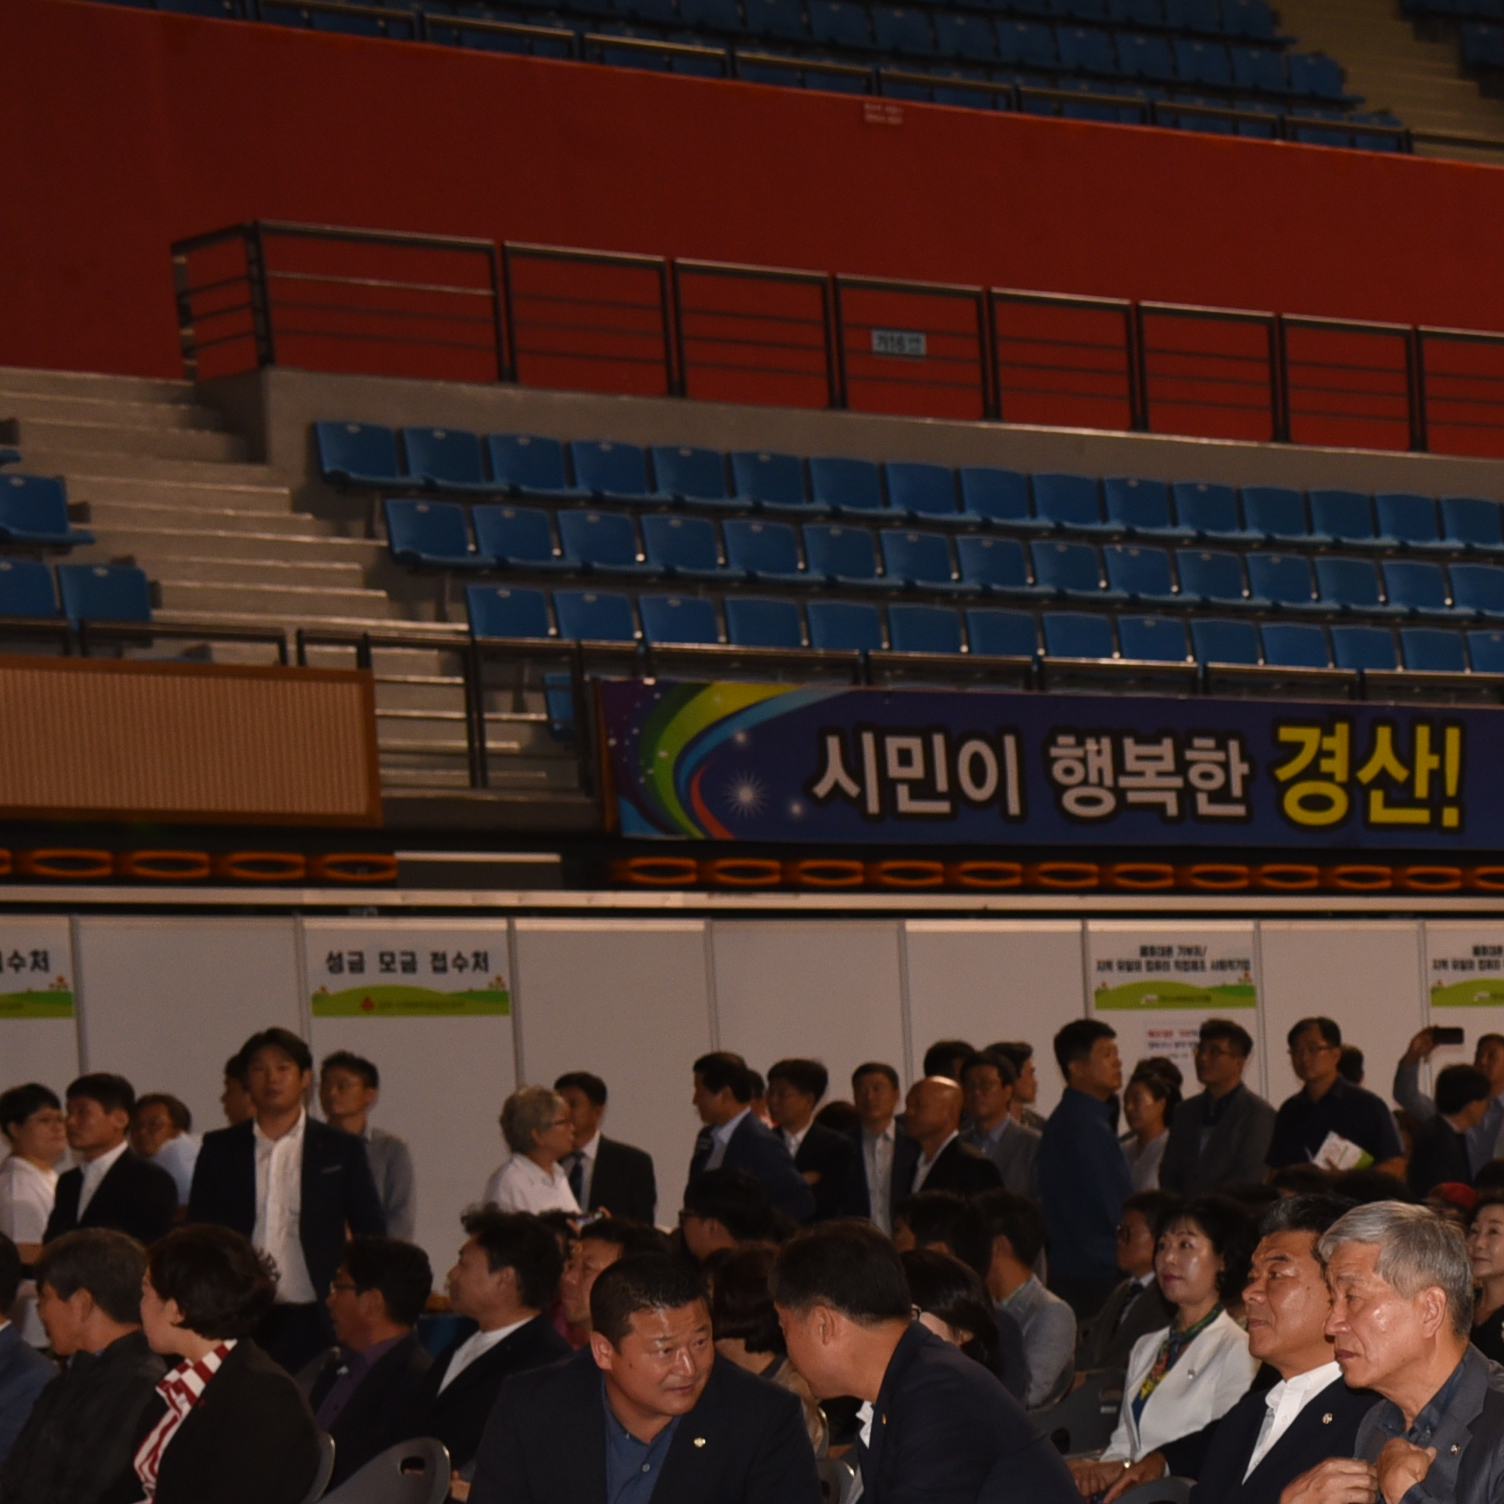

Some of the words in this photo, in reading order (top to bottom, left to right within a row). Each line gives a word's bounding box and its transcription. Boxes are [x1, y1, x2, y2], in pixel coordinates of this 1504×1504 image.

[812, 730, 1023, 818] 시민이
[1050, 733, 1249, 819] 행복한
[1274, 723, 1462, 828] 경산!
[0, 949, 50, 974] 수처
[325, 950, 366, 974] 성금
[378, 951, 417, 974] 모금
[430, 951, 490, 974] 접수처
